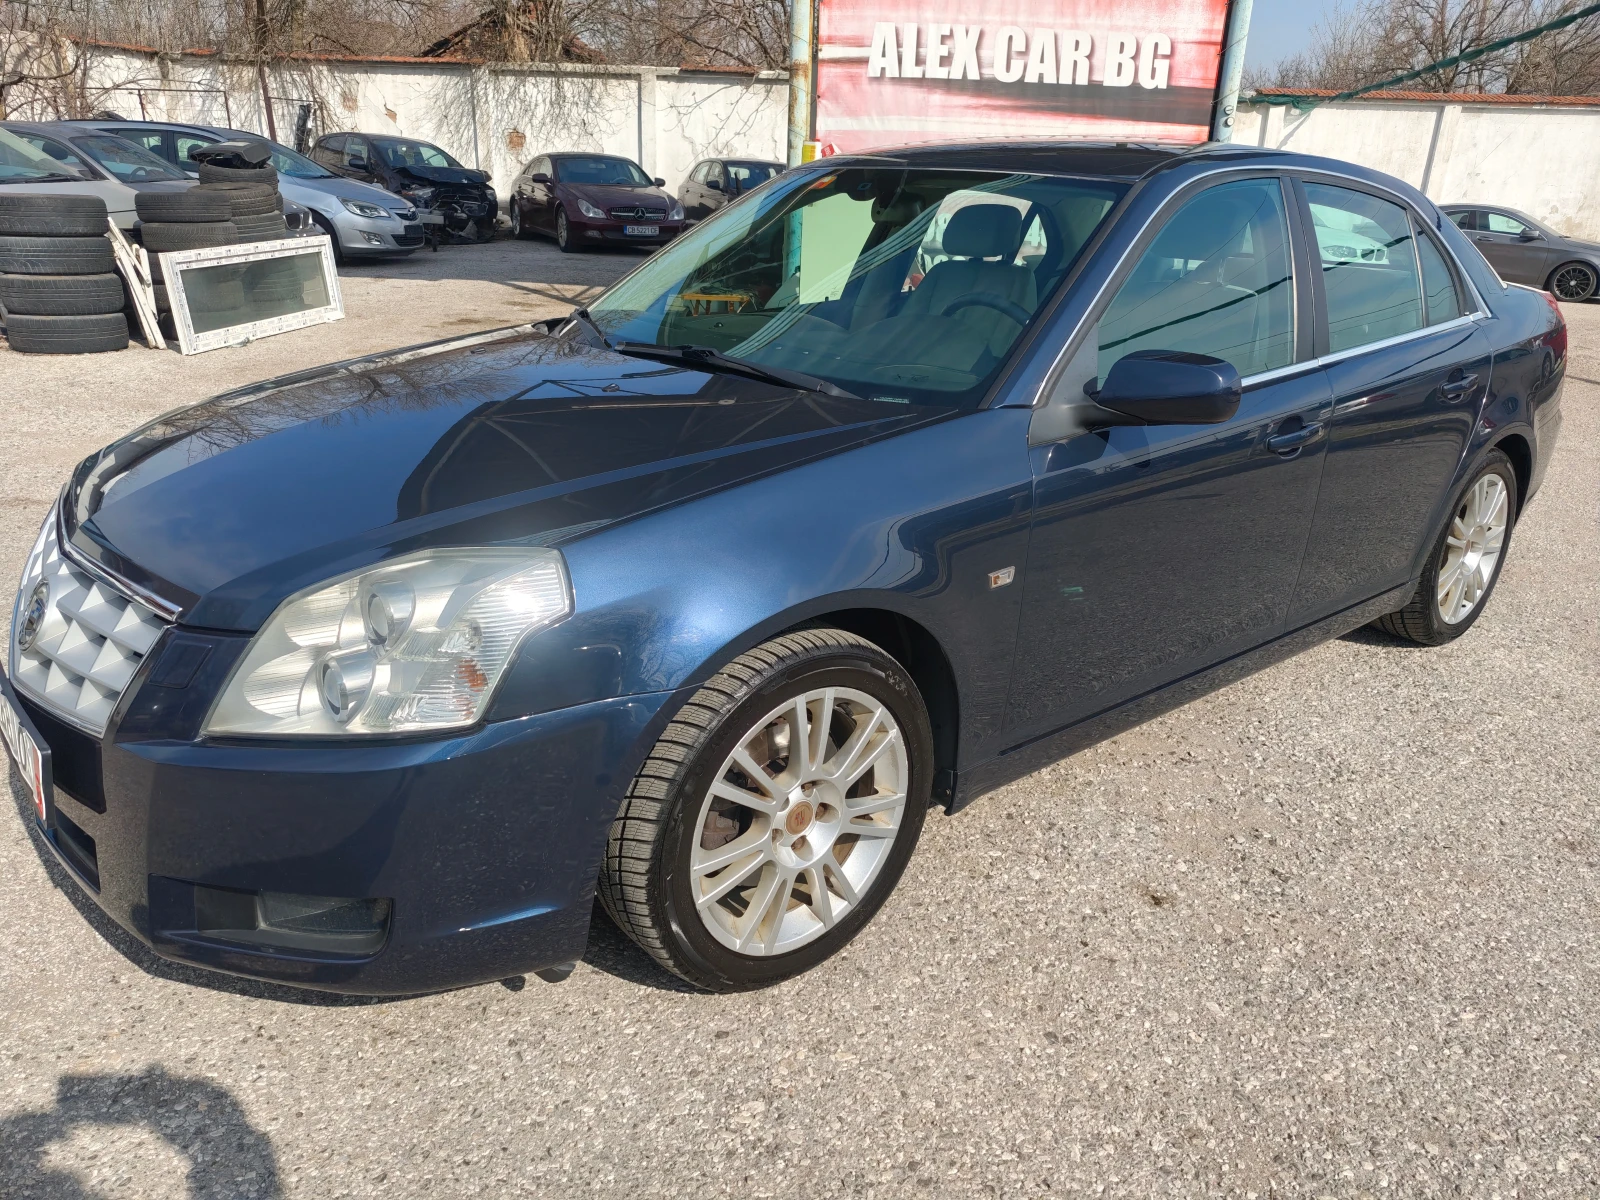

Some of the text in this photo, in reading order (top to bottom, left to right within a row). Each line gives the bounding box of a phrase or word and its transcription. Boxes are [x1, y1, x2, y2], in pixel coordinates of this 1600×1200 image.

[867, 21, 1172, 90] ALEX CAR BG
[636, 226, 650, 234] 5221
